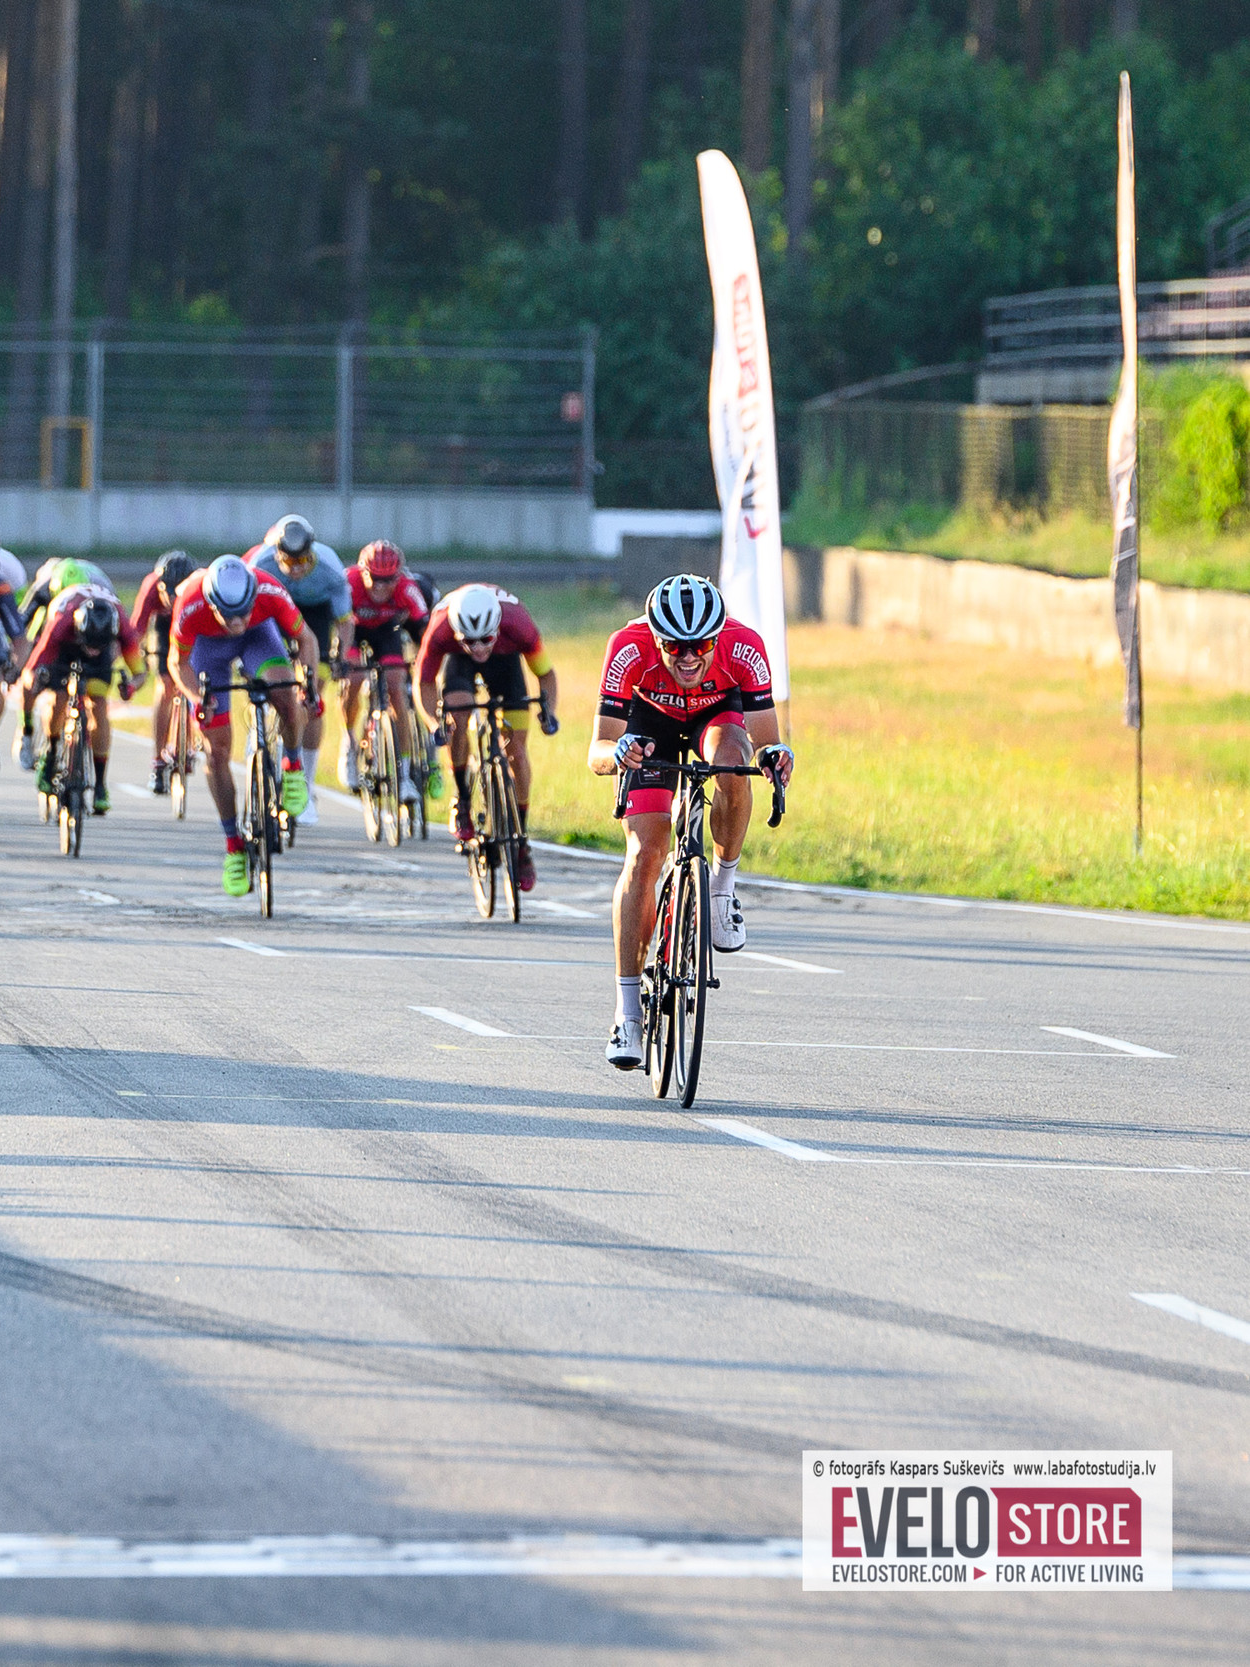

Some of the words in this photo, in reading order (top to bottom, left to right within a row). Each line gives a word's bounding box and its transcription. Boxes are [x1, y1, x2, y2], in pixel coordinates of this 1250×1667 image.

[732, 641, 761, 667] EVELO
[605, 661, 625, 693] EVELO
[645, 691, 685, 708] VELO
